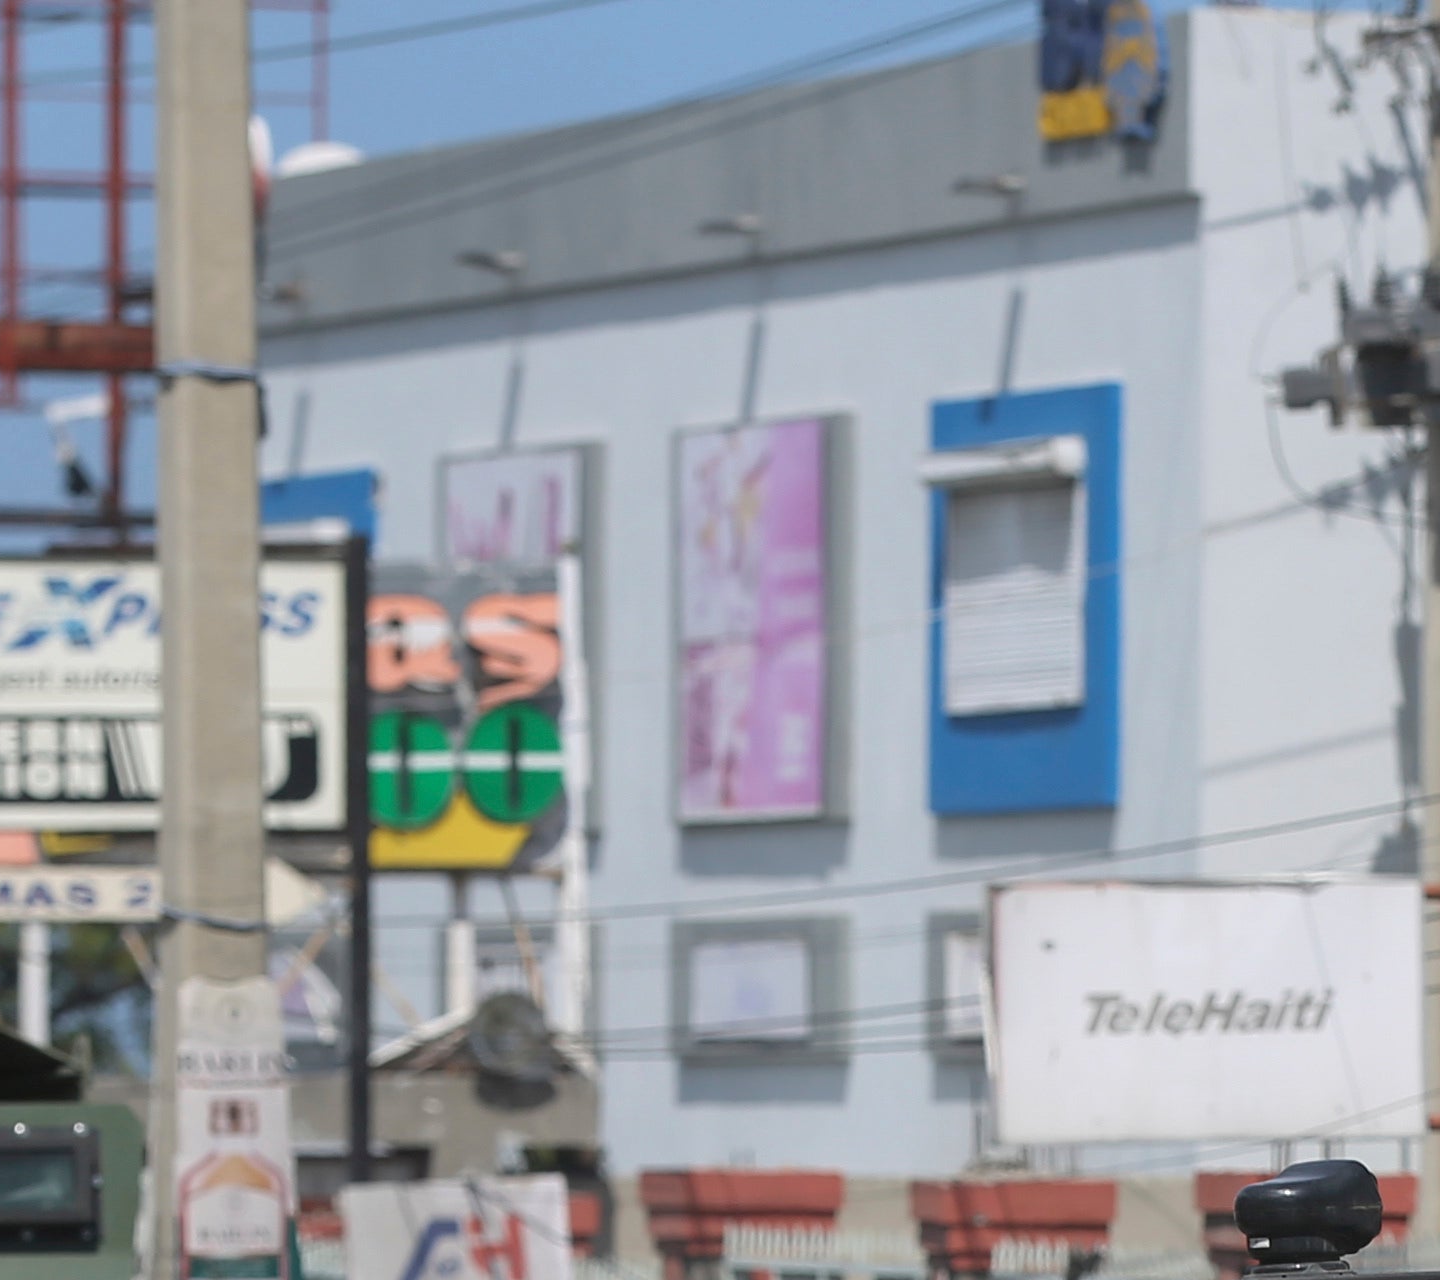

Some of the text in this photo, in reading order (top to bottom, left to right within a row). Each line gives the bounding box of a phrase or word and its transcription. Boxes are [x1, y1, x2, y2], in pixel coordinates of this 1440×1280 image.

[61, 668, 160, 691] autoris
[125, 877, 153, 909] 2
[1081, 988, 1334, 1037] TeleHaiti
